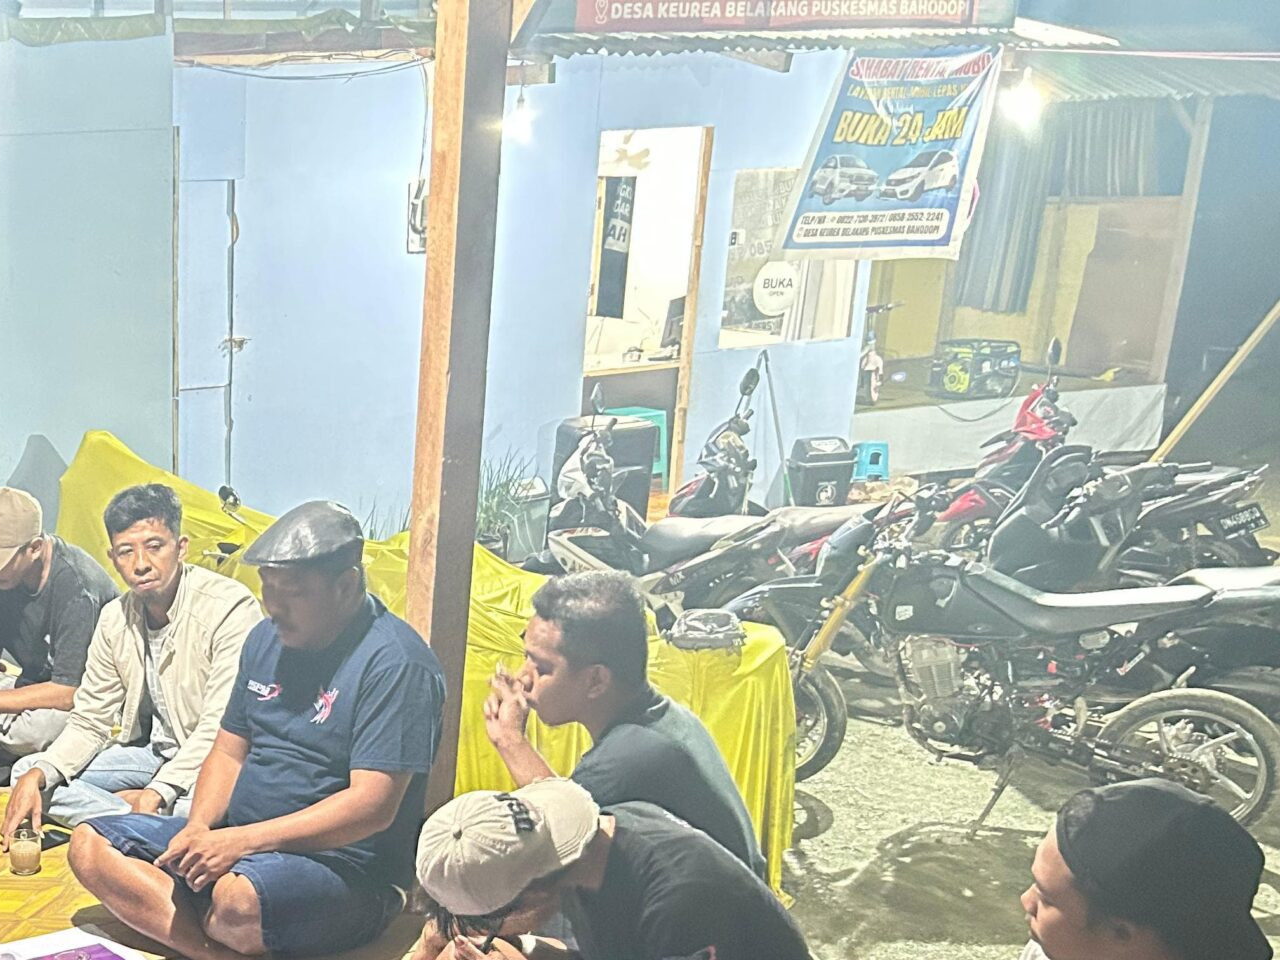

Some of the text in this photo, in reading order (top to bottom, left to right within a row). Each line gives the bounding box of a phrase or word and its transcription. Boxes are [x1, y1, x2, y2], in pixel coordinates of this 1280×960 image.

[610, 3, 654, 20] DESA
[657, 2, 721, 18] KEUREA
[812, 0, 897, 16] PUSKESMAS
[900, 0, 969, 16] BAHODOPI
[833, 106, 969, 146] BUKA 24 JAM
[762, 278, 793, 289] BUKA
